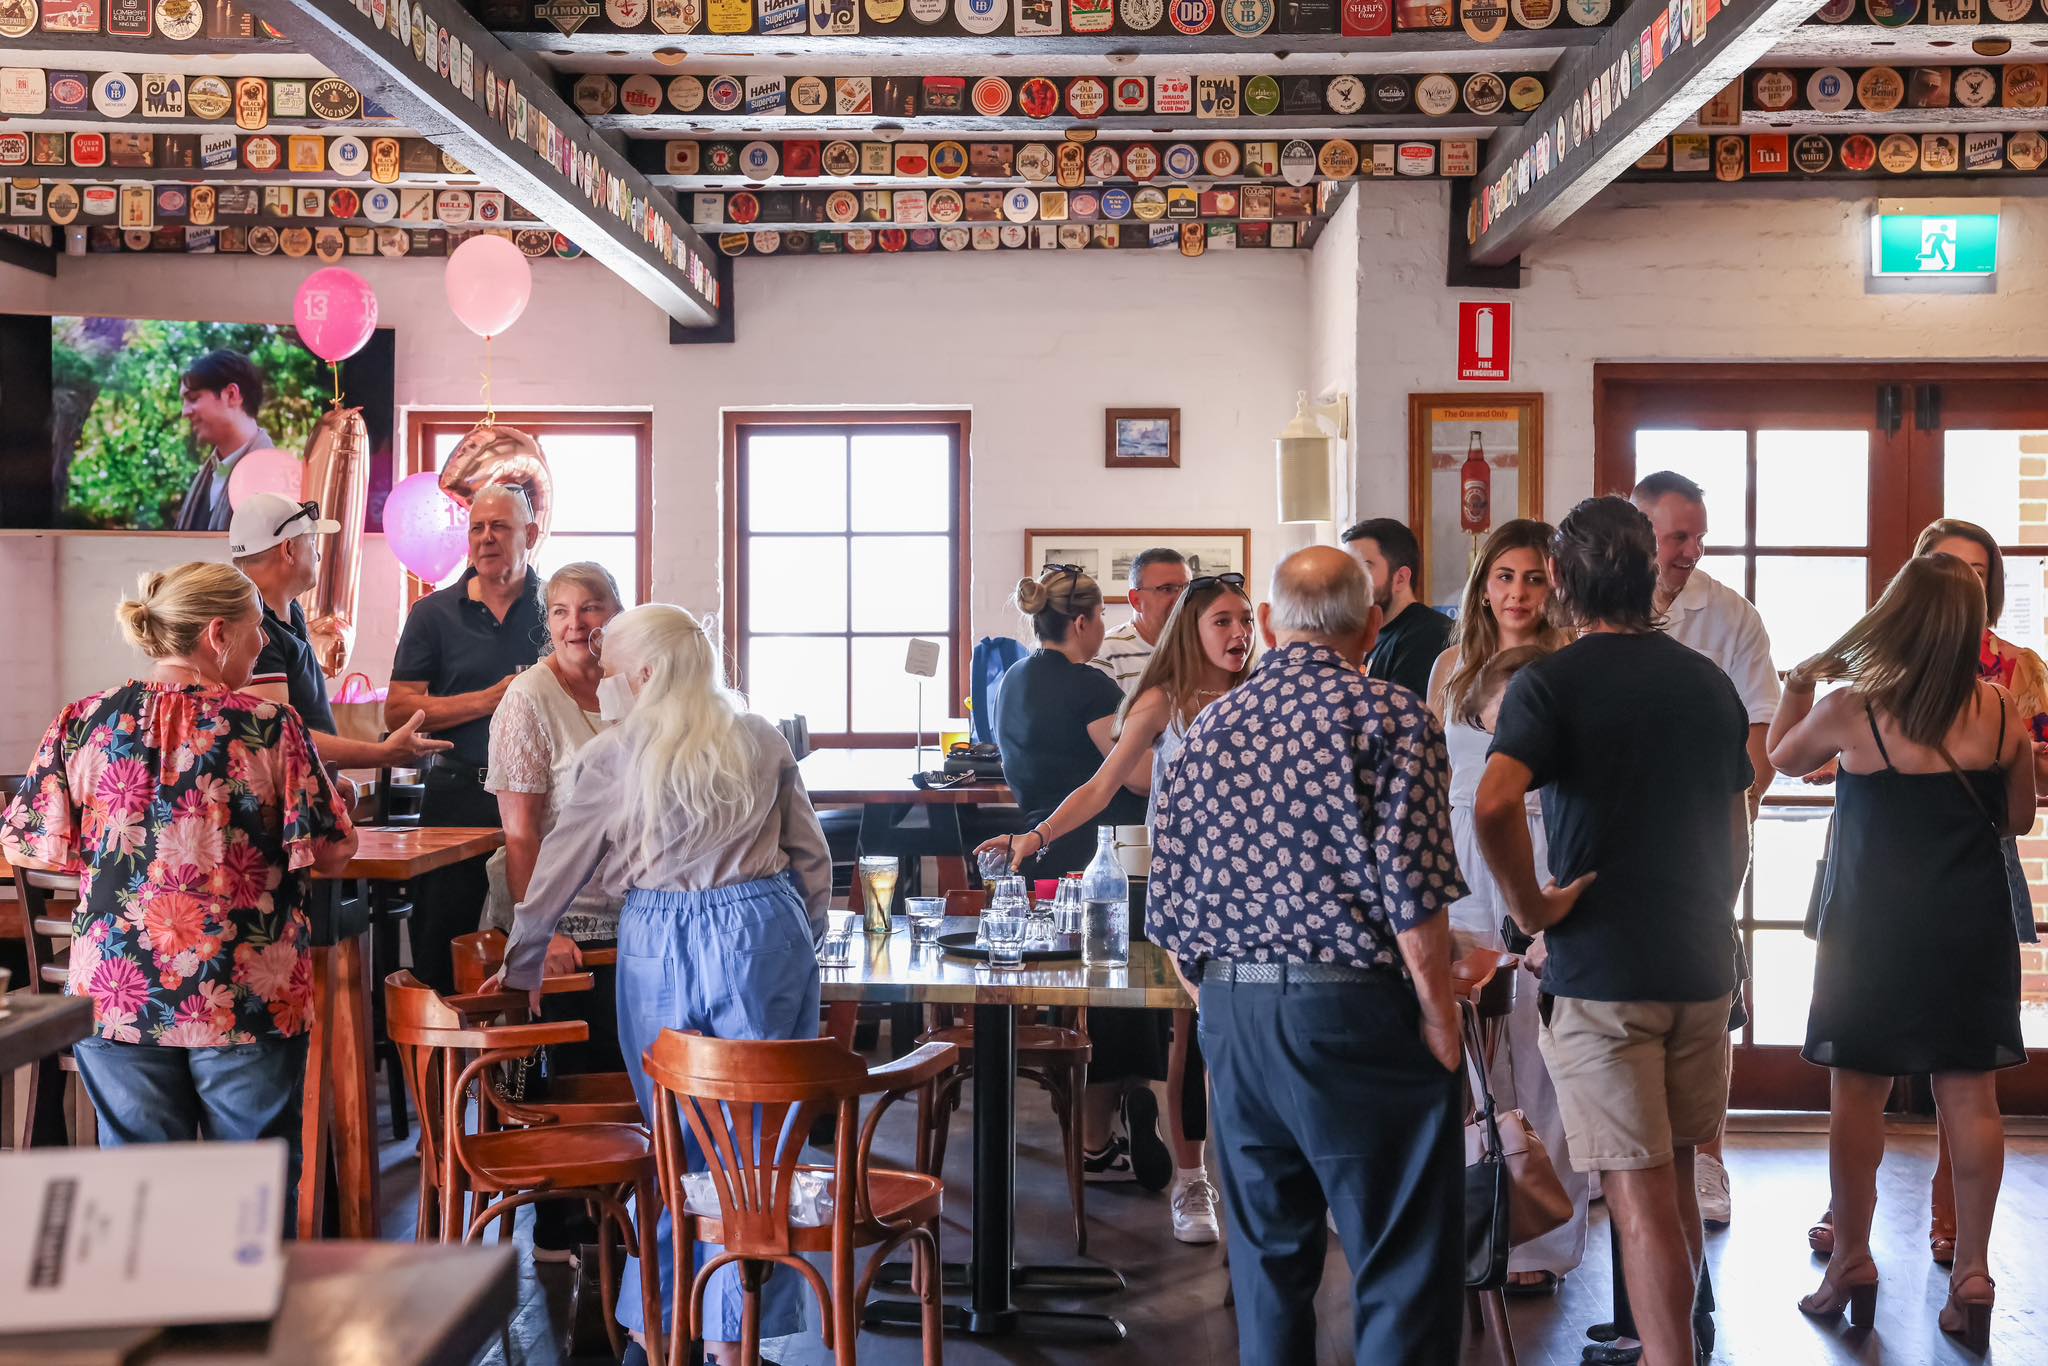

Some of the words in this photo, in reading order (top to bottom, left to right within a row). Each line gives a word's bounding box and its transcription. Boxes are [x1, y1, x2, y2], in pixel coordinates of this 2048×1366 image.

[537, 6, 597, 16] DIAMOND
[1180, 2, 1204, 21] DB
[1350, 5, 1383, 13] SHARP'S
[1465, 9, 1504, 18] SCOTTISH
[765, 8, 799, 26] SuperDry
[1240, 11, 1256, 22] HB
[1199, 77, 1235, 88] ORVAL
[314, 81, 354, 100] FLOWERS
[751, 81, 780, 98] HAHN
[625, 92, 657, 107] Haig
[315, 102, 354, 117] ORIGINAL
[77, 138, 99, 147] QUEEN
[205, 139, 231, 154] HAHN
[1970, 138, 1998, 153] HAHN
[81, 145, 99, 153] ANNE
[1758, 148, 1781, 163] Tui
[1801, 153, 1825, 161] WHITE
[1152, 225, 1175, 235] HAHN
[304, 295, 328, 317] 13
[1478, 361, 1492, 369] FIRE
[1463, 369, 1504, 377] EXTINGUISHER
[1444, 410, 1458, 418] The
[1459, 410, 1473, 418] One
[1476, 410, 1490, 418] and
[1491, 410, 1508, 420] Only
